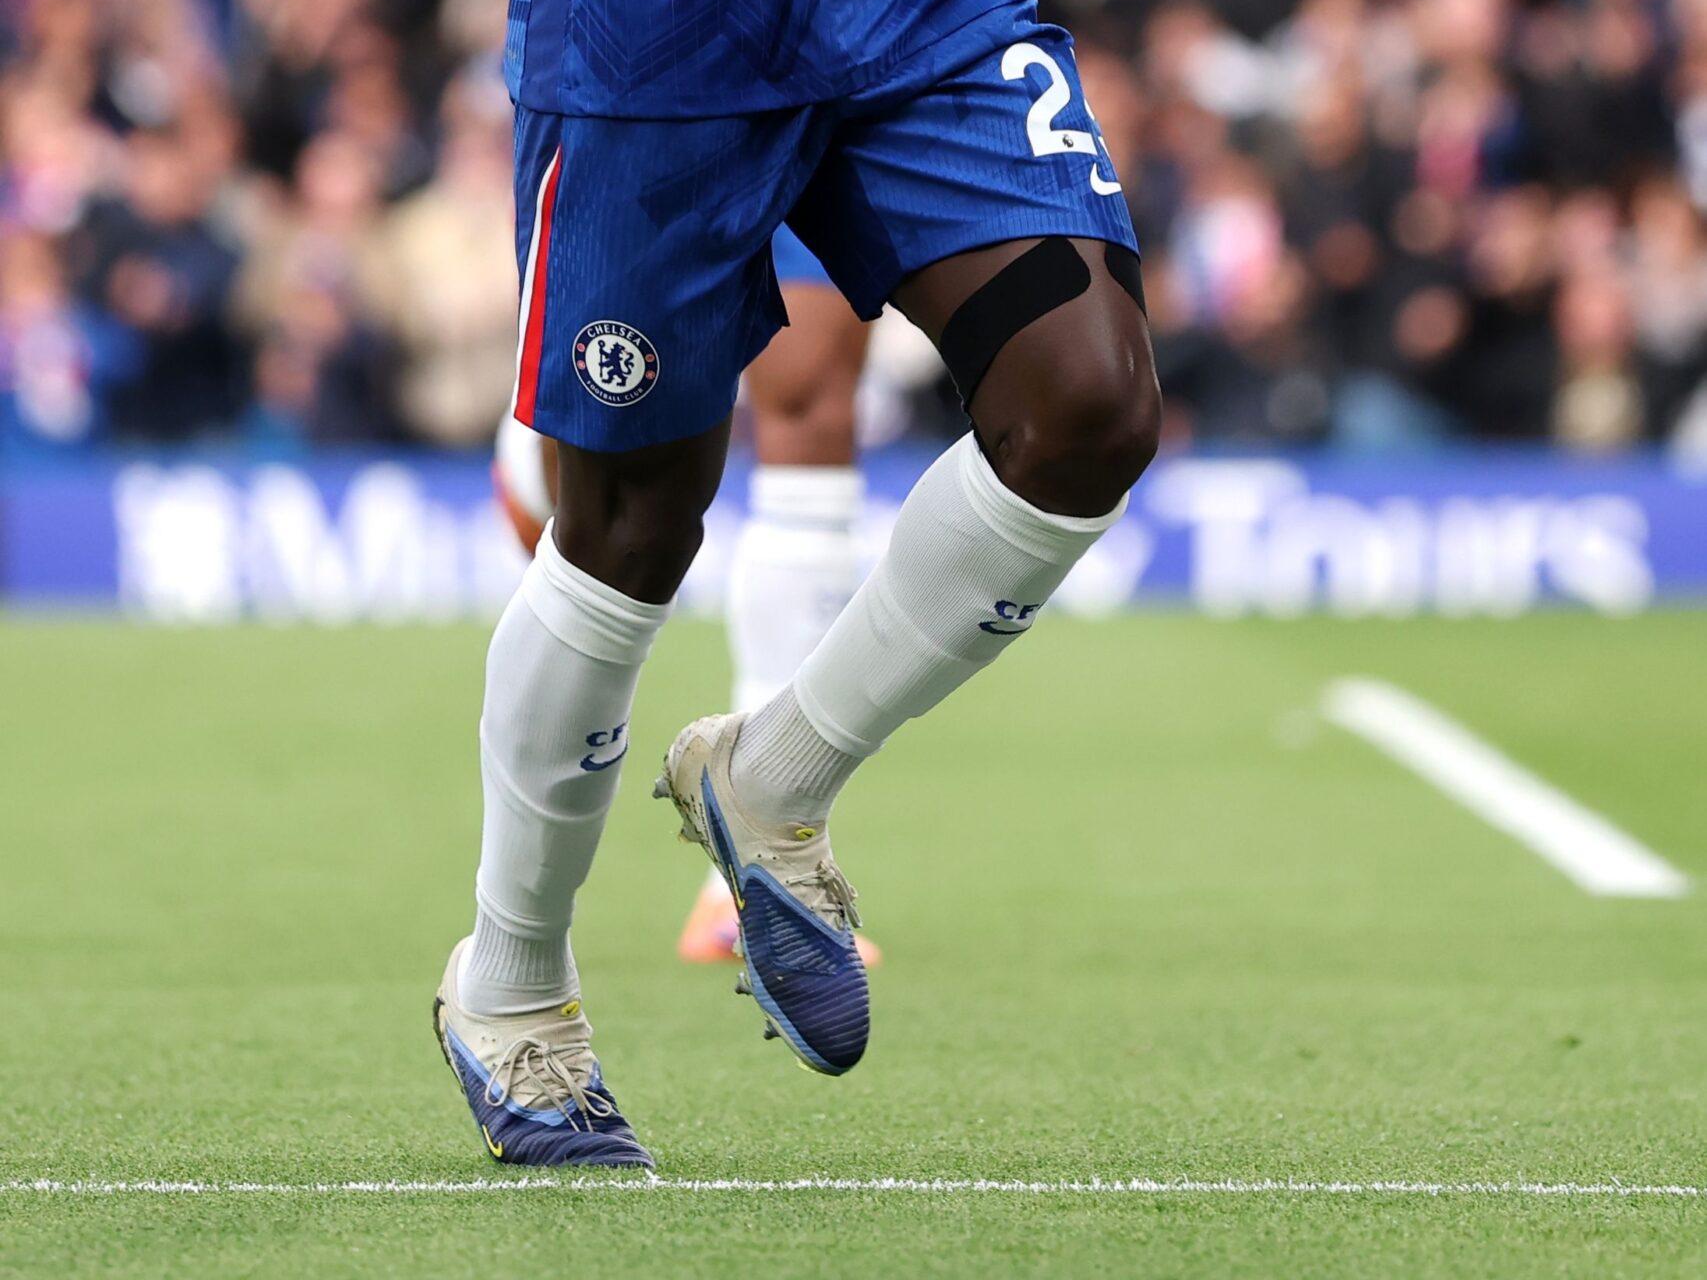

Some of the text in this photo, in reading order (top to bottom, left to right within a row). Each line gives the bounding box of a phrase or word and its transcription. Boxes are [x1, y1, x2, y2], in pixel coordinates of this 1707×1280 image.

[1001, 43, 1110, 157] 2
[586, 324, 642, 346] CHELSEA
[586, 380, 645, 402] FOOTBALL CLUB
[994, 600, 1047, 620] CF
